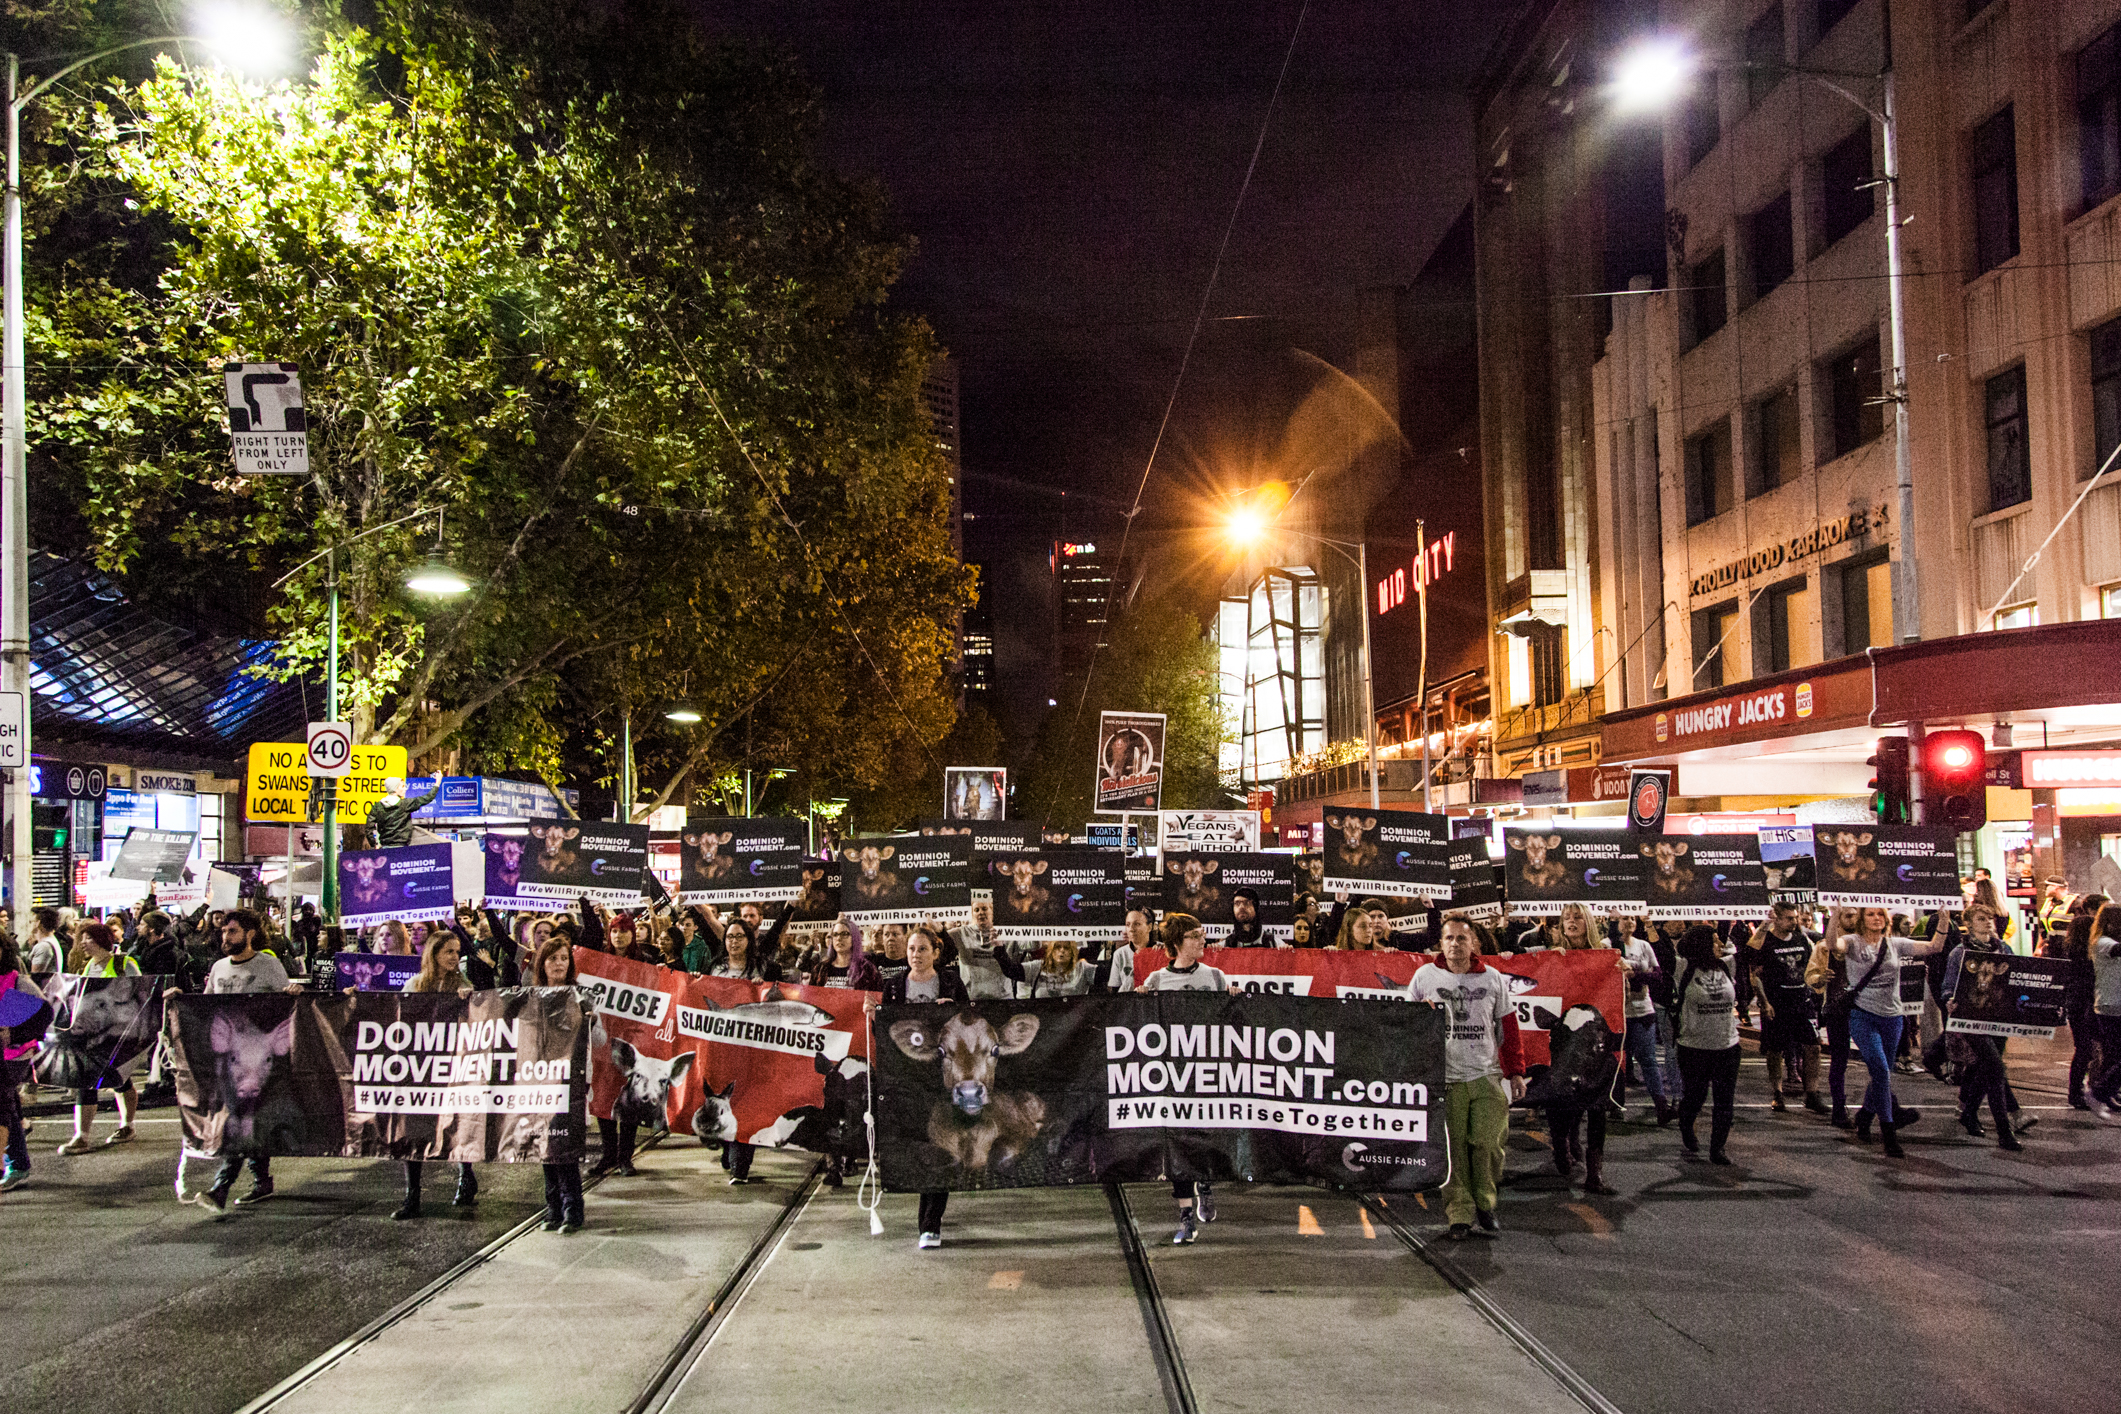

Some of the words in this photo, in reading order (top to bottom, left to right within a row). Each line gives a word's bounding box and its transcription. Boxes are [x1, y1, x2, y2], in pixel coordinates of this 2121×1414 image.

[236, 437, 269, 446] RIGHT
[274, 437, 305, 446] TURN
[239, 449, 269, 458] FROM
[276, 448, 303, 458] LEFT
[257, 461, 287, 470] ONLY
[623, 505, 638, 516] 48
[1077, 542, 1095, 553] nib
[1700, 544, 1785, 596] HOLLYWOOD
[1784, 511, 1869, 564] KARAOKE
[1379, 568, 1404, 614] MID
[1675, 703, 1732, 736] HUNGRY
[1738, 692, 1785, 725] JACK'S
[313, 740, 345, 759] 40
[270, 752, 292, 768] NO
[367, 755, 387, 770] TO
[2000, 770, 2010, 779] St
[141, 776, 181, 790] SMOKE
[343, 777, 387, 793] STREE
[446, 786, 474, 794] Colliers
[253, 798, 296, 814] LOCAL
[1176, 815, 1236, 830] VEGANS
[1095, 828, 1116, 836] GOATS
[1287, 829, 1309, 839] MID
[1381, 826, 1431, 837] DOMINION
[130, 832, 149, 842] STOP
[150, 833, 164, 843] THE
[165, 834, 192, 844] KILLING
[581, 836, 630, 846] DOMINION
[736, 837, 784, 845] DOMINION
[975, 836, 1024, 844] DOMINION
[1381, 835, 1447, 846] MOVEMENT.com
[580, 843, 645, 854] MOVEMENT.com
[736, 844, 800, 852] MOVEMENT.com
[975, 844, 1040, 852] MOVEMENT.com
[1878, 842, 1935, 850] DOMINION
[899, 852, 950, 862] DOMINION
[1566, 851, 1639, 859] MOVEMENT.com
[1693, 850, 1744, 858] DOMINION
[1878, 849, 1955, 858] MOVEMENT.com
[390, 859, 435, 869] DOMINION
[899, 859, 968, 869] MOVEMENT.com
[1694, 858, 1761, 866] MOVEMENT.com
[390, 866, 451, 876] MOVEMENT.com
[1052, 869, 1105, 877] DOMINION
[1222, 869, 1274, 877] DOMINION
[1052, 877, 1123, 885] MOVEMENT.com
[521, 885, 638, 900] #WeWillRiseTogether
[1327, 880, 1448, 896] #WeWillRiseTogether
[1784, 893, 1795, 904] TO
[1797, 891, 1816, 904] LIVE
[1822, 894, 1959, 906] #WeWillRiseTogether
[997, 929, 1122, 938] #WeWillRiseTogether
[2010, 972, 2053, 982] DOMINION
[2008, 979, 2064, 990] MOVEMENT.com
[356, 1018, 519, 1052] DOMINION
[655, 1018, 676, 1043] all
[681, 1010, 826, 1052] SLAUGHTERHOUSES
[1105, 1023, 1334, 1064] DOMINION
[353, 1052, 571, 1083] MOVEMENT.com
[1107, 1060, 1428, 1105] MOVEMENT.com
[1116, 1102, 1419, 1133] #WeWillRiseTogether
[1359, 1154, 1392, 1165] AUSSIE
[1395, 1156, 1427, 1167] FARMS
